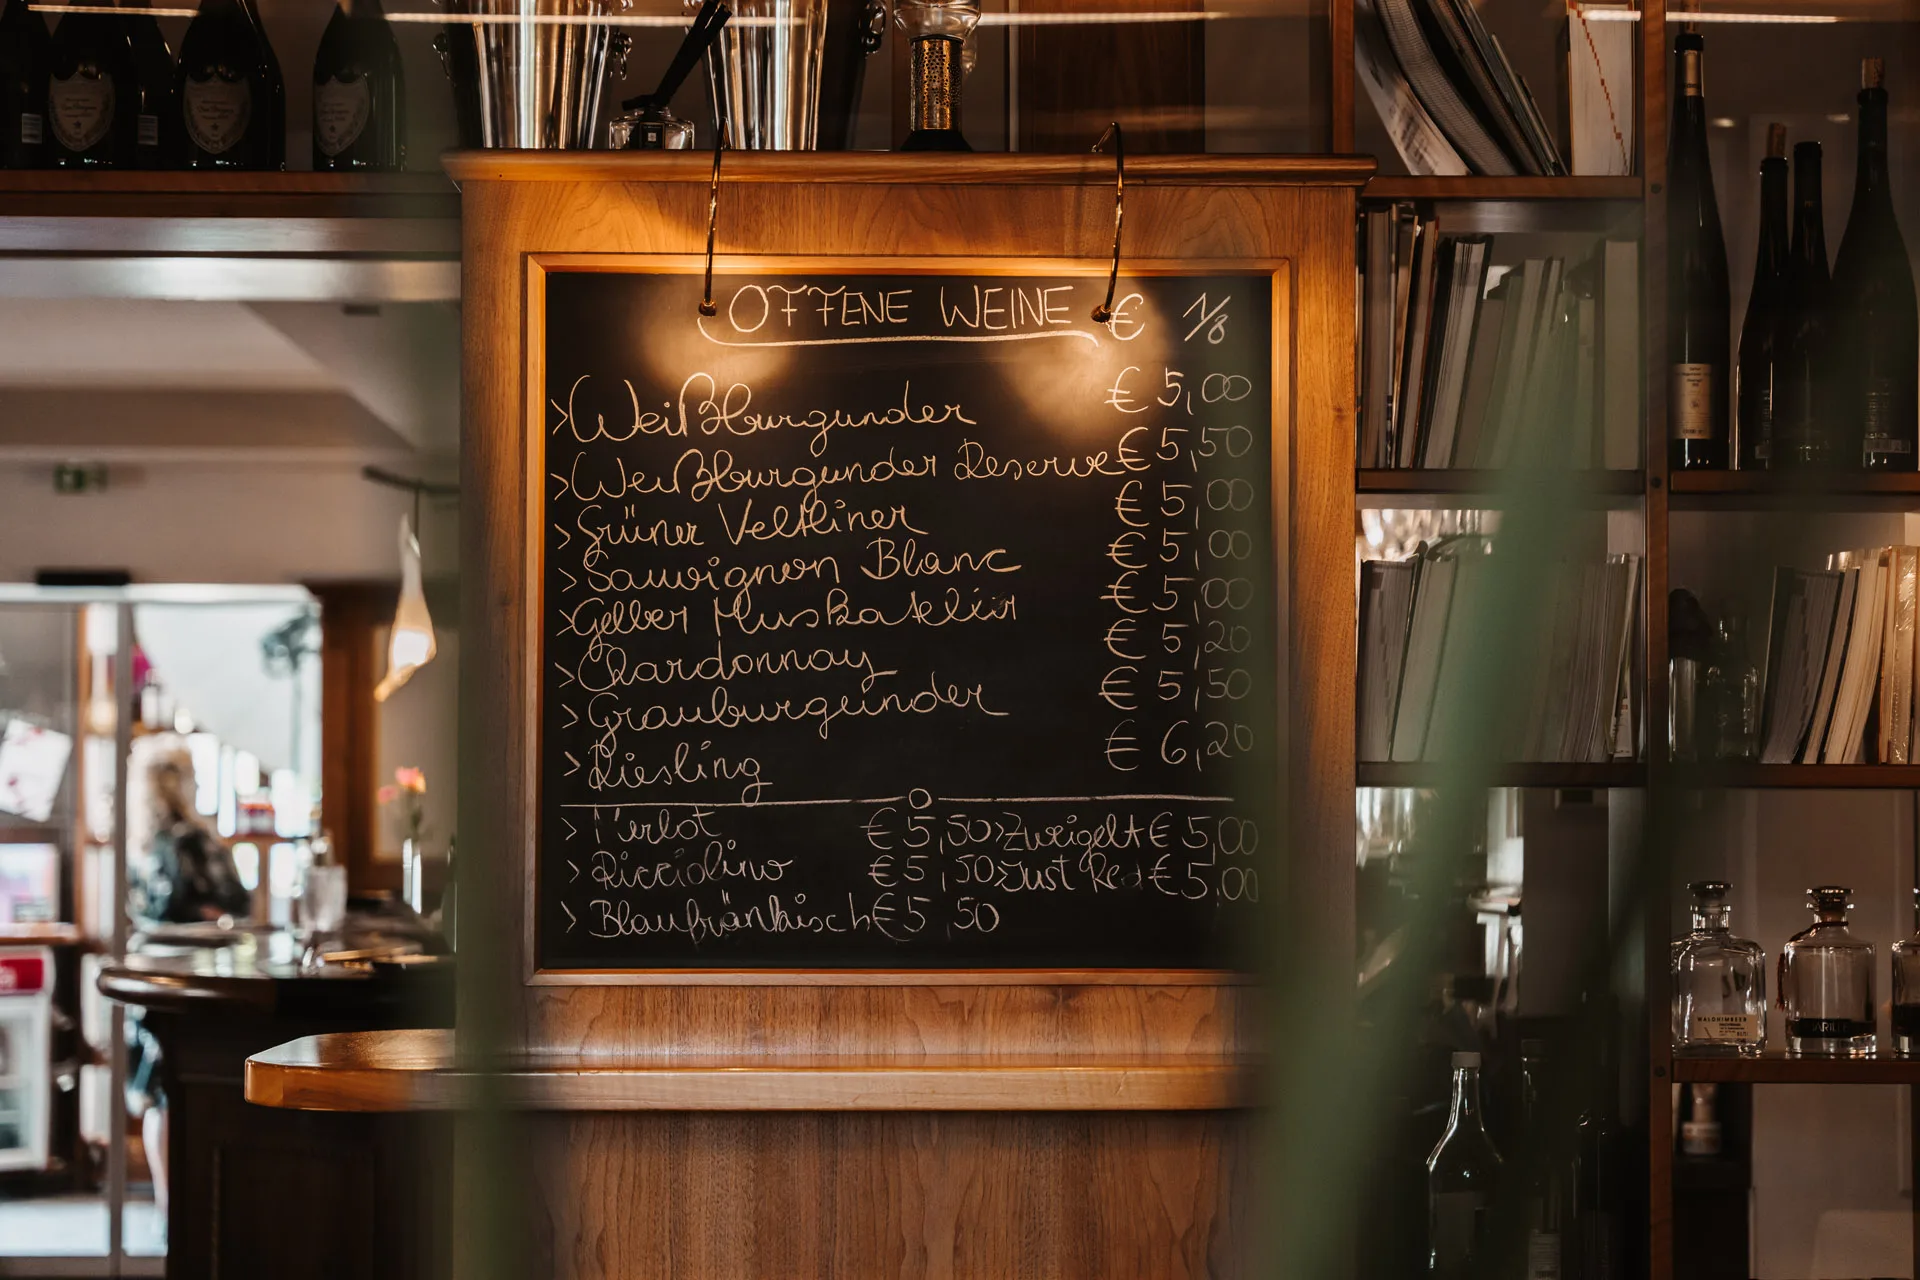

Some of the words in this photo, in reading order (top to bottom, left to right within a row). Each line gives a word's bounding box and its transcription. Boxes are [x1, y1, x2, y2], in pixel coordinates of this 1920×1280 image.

[940, 284, 1074, 330] WEINE
[1109, 293, 1145, 341] €
[1182, 292, 1232, 345] 1/8
[568, 372, 978, 458] Weißburgunder
[1104, 366, 1149, 413] €
[1157, 366, 1252, 416] 5,00
[953, 438, 1126, 482] Reserve
[1116, 426, 1151, 472] €
[1156, 425, 1253, 473] 5,50
[1115, 480, 1150, 527] €
[1161, 478, 1254, 530] 5,00
[860, 536, 1022, 580] Blanc
[1105, 531, 1148, 569] €
[1160, 527, 1252, 571] 5,00
[1100, 570, 1149, 614] €
[1152, 574, 1254, 624] 5,00
[577, 639, 898, 694] Chardonnay
[1103, 618, 1147, 660] €
[1162, 620, 1252, 671] 5,20
[1098, 665, 1139, 710] €
[1157, 668, 1252, 713] 5,50
[587, 739, 773, 808] Riesling
[1103, 718, 1141, 772] €
[1160, 719, 1254, 772] 6,20
[859, 806, 897, 850] €
[902, 813, 992, 855] 5,50
[1002, 811, 1146, 872] Zweigelt
[1149, 811, 1173, 848] €
[1181, 815, 1259, 865] 5,00
[867, 854, 899, 887] €
[902, 853, 995, 893] 5,50
[1000, 853, 1076, 893] Just
[1147, 853, 1179, 896] €
[1180, 861, 1259, 908] 5,00
[872, 892, 911, 942] €
